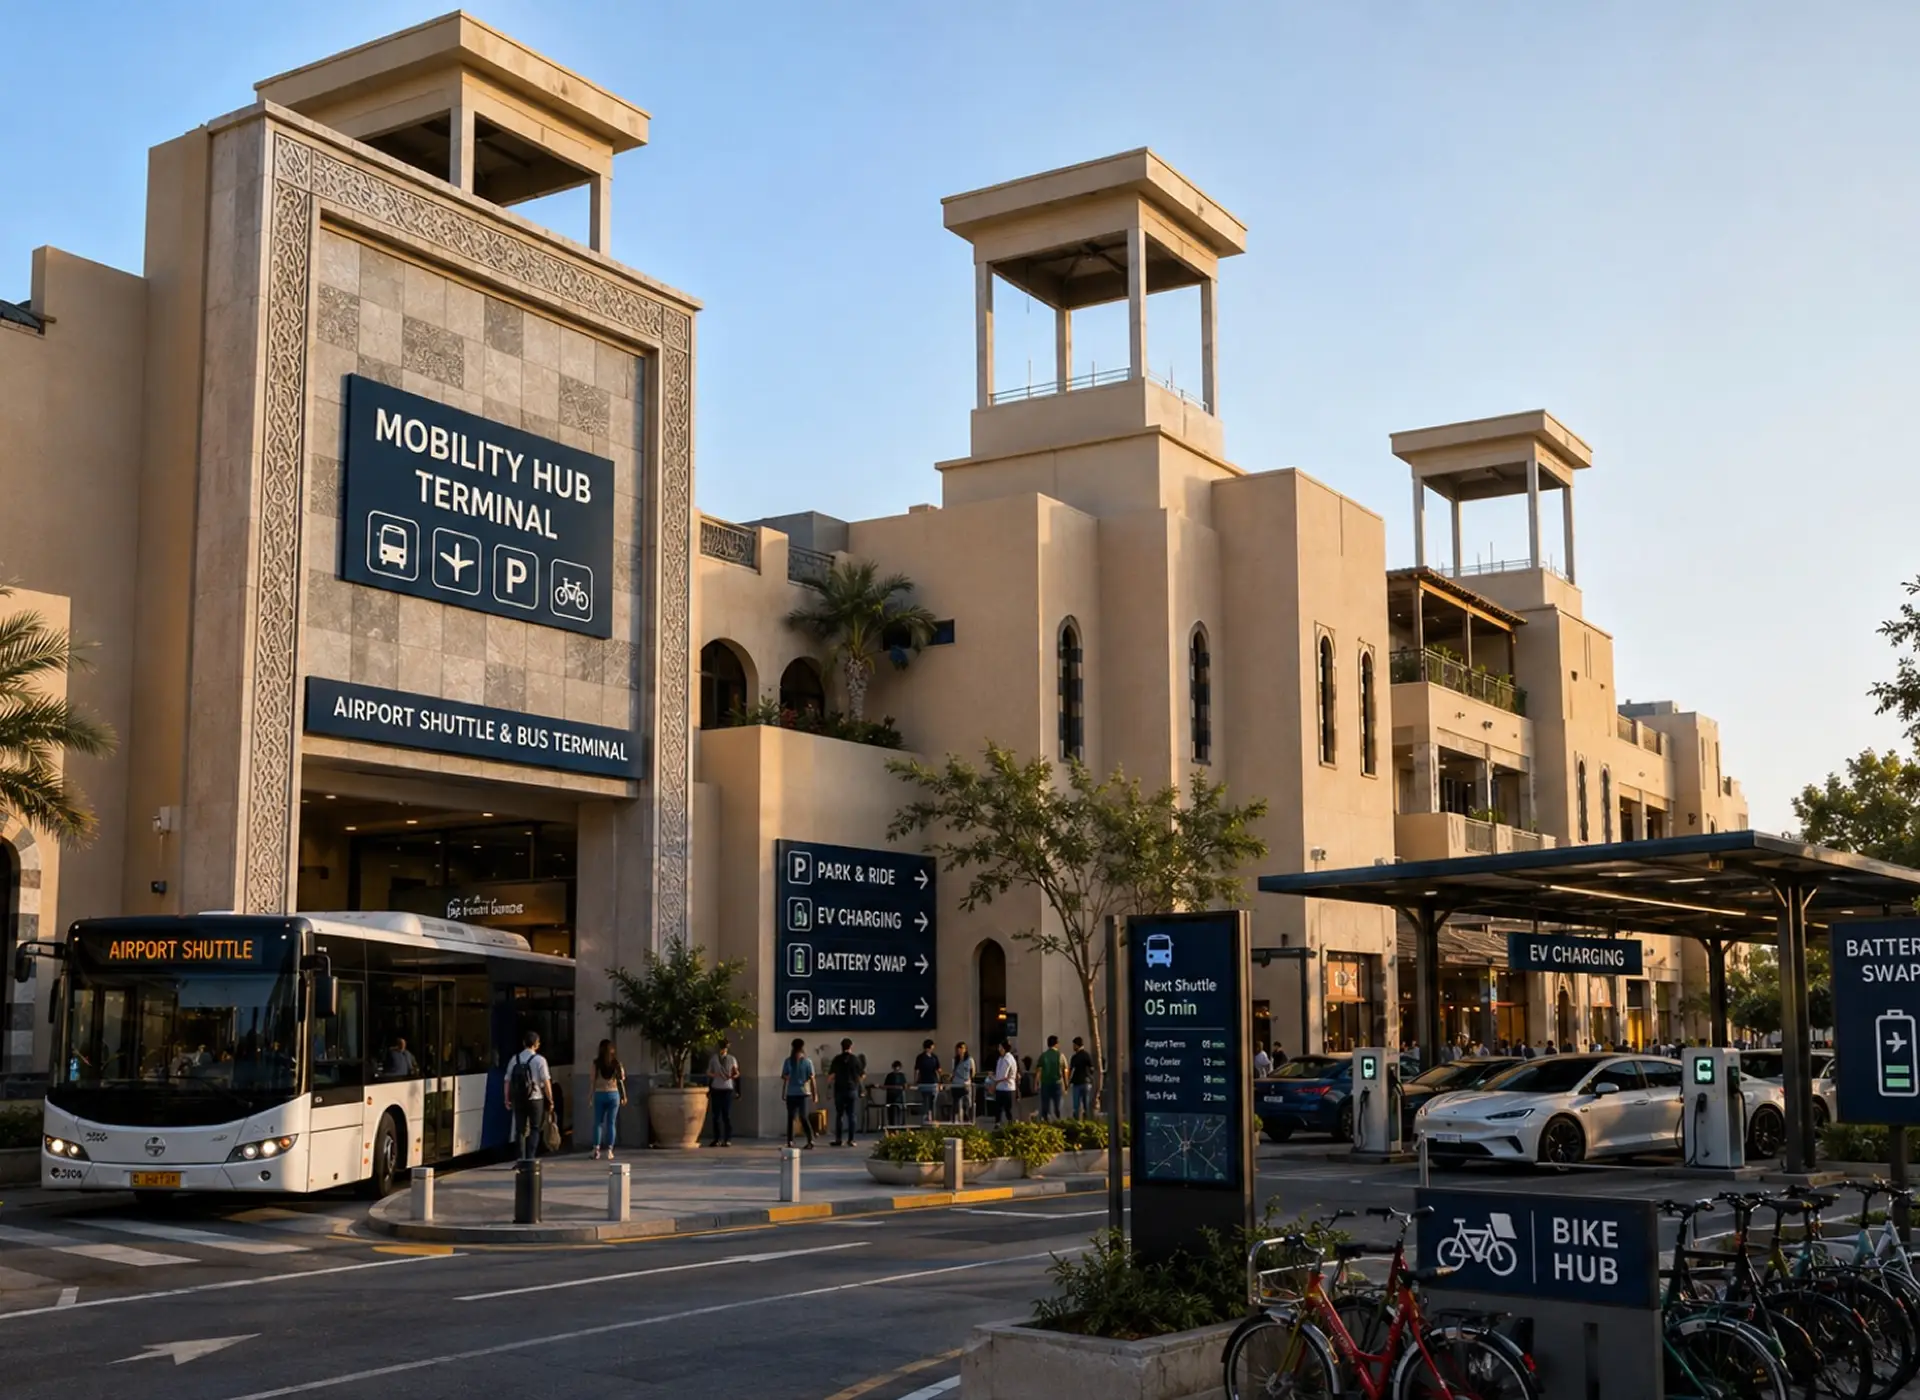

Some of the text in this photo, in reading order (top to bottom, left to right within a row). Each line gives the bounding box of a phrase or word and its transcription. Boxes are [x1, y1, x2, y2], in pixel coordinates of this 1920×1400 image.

[375, 408, 592, 504] MOBILITY HUB
[415, 469, 558, 540] TERMINAL
[506, 557, 528, 594] P
[333, 696, 628, 762] AIRPORT SHUTTLE & BUS TERMINAL
[794, 857, 807, 879] P
[817, 861, 896, 886] PARK & RIDE
[817, 907, 902, 930] EV CHARGING
[109, 940, 253, 960] AIRPORT SHUTTLE
[1530, 944, 1624, 967] EV CHARGING
[1846, 937, 1920, 957] BATTER
[817, 952, 907, 973] BATTERY SWAP
[1862, 963, 1920, 982] SWAP
[1144, 978, 1217, 992] Next Shuttle
[817, 998, 876, 1016] BIKE HUB
[1144, 999, 1197, 1016] 05 min
[1553, 1217, 1618, 1248] BIKE
[1554, 1252, 1618, 1285] HUB
